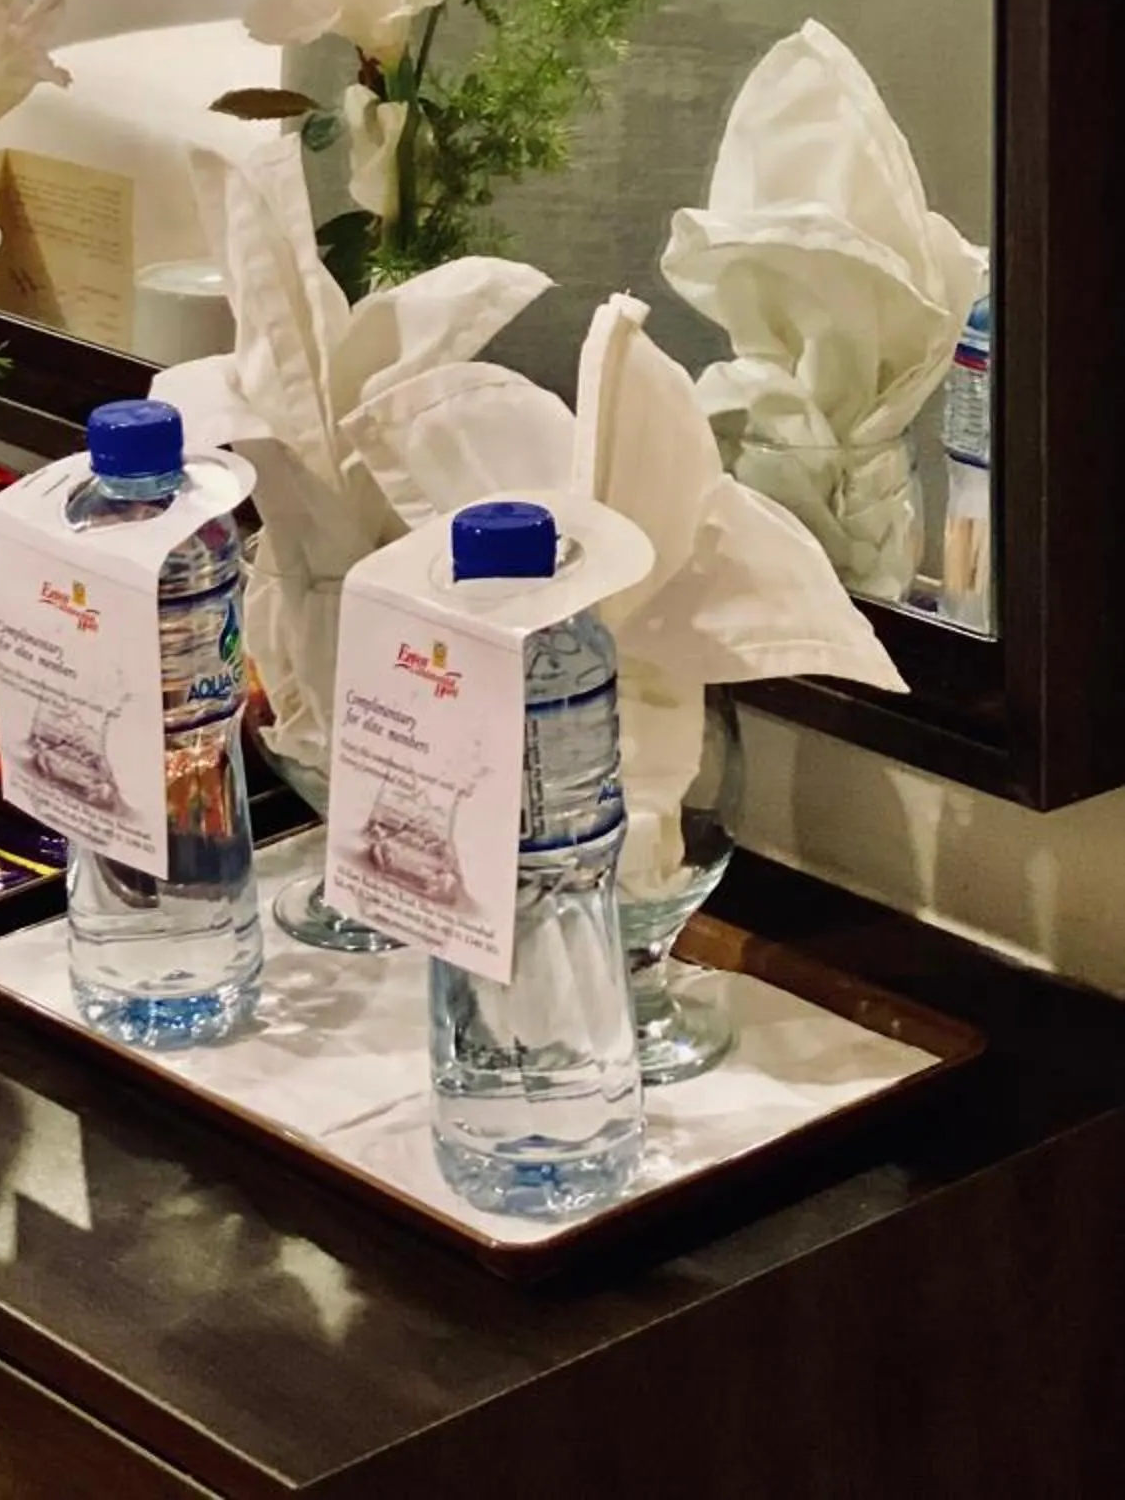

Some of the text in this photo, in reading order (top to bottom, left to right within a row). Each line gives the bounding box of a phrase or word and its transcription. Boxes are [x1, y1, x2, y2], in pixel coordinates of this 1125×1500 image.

[186, 673, 232, 703] AQUA
[346, 688, 417, 732] Complimentary
[342, 706, 360, 727] for
[387, 728, 431, 755] members
